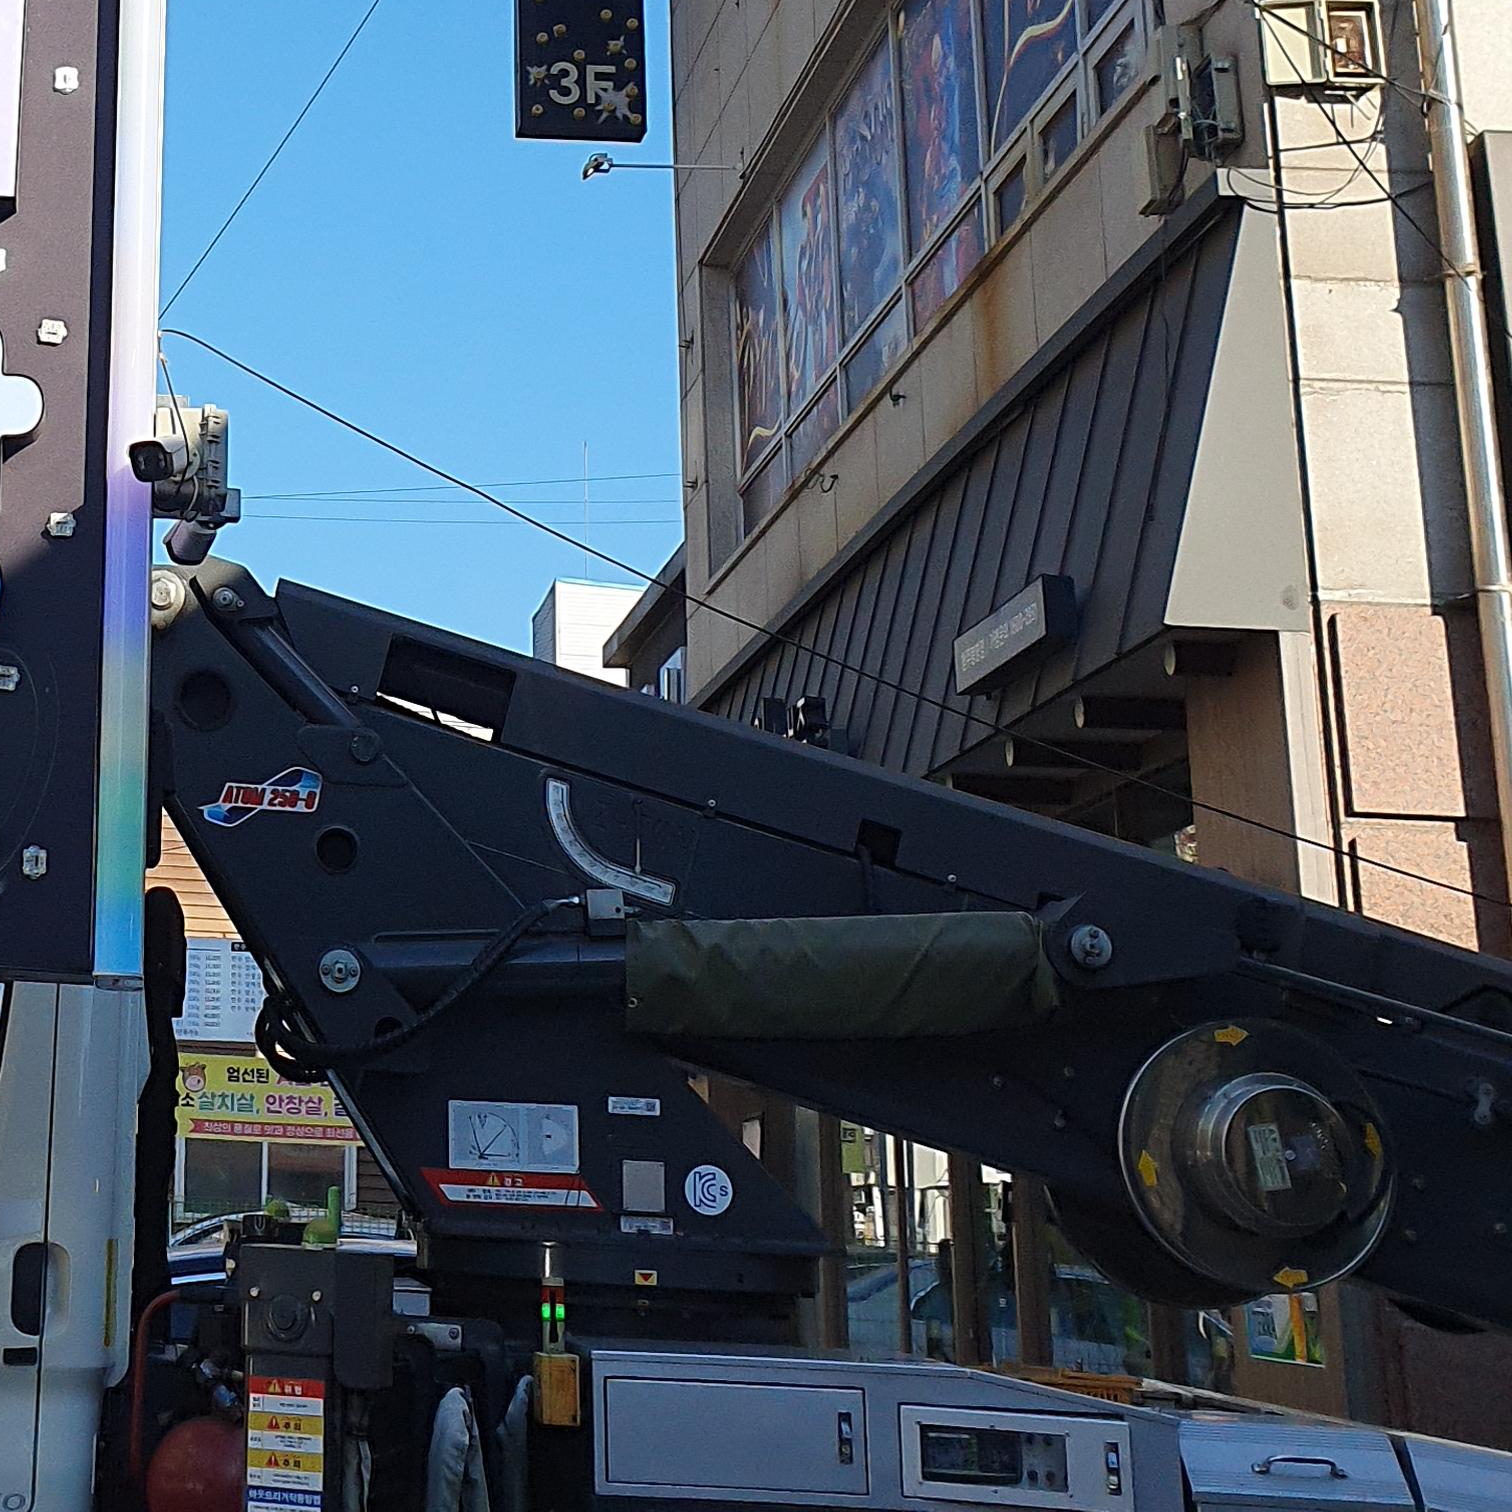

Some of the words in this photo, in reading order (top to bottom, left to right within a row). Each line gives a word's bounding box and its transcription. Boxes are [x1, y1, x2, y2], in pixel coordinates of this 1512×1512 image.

[548, 61, 617, 105] 3F
[226, 1066, 270, 1084] 엄선된
[265, 1094, 329, 1117] 안창살,
